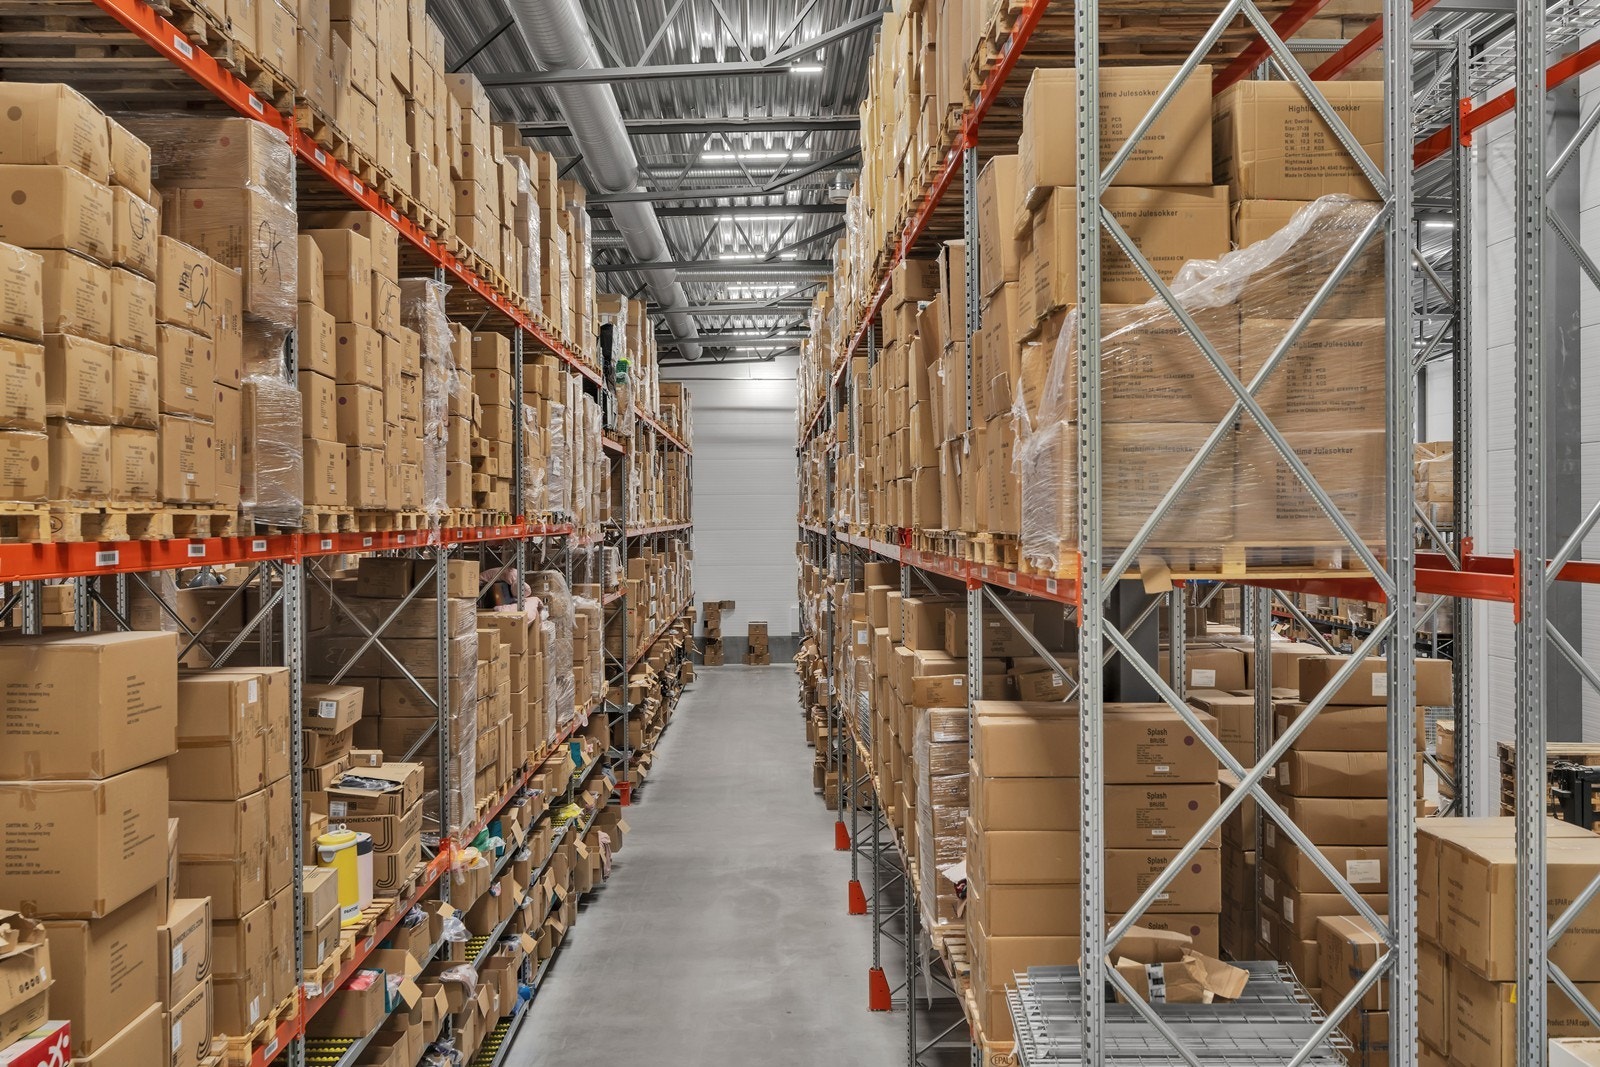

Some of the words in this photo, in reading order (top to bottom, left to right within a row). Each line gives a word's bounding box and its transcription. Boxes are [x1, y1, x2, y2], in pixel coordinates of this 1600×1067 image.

[1119, 89, 1159, 98] Julesokker
[1138, 209, 1178, 218] Julesokker
[1323, 340, 1364, 348] Julesokker
[1313, 447, 1353, 455] Julesokker
[1147, 728, 1168, 737] Splash
[1146, 791, 1168, 801] Splash
[1146, 856, 1168, 866] Splash
[1147, 921, 1168, 930] Splash
